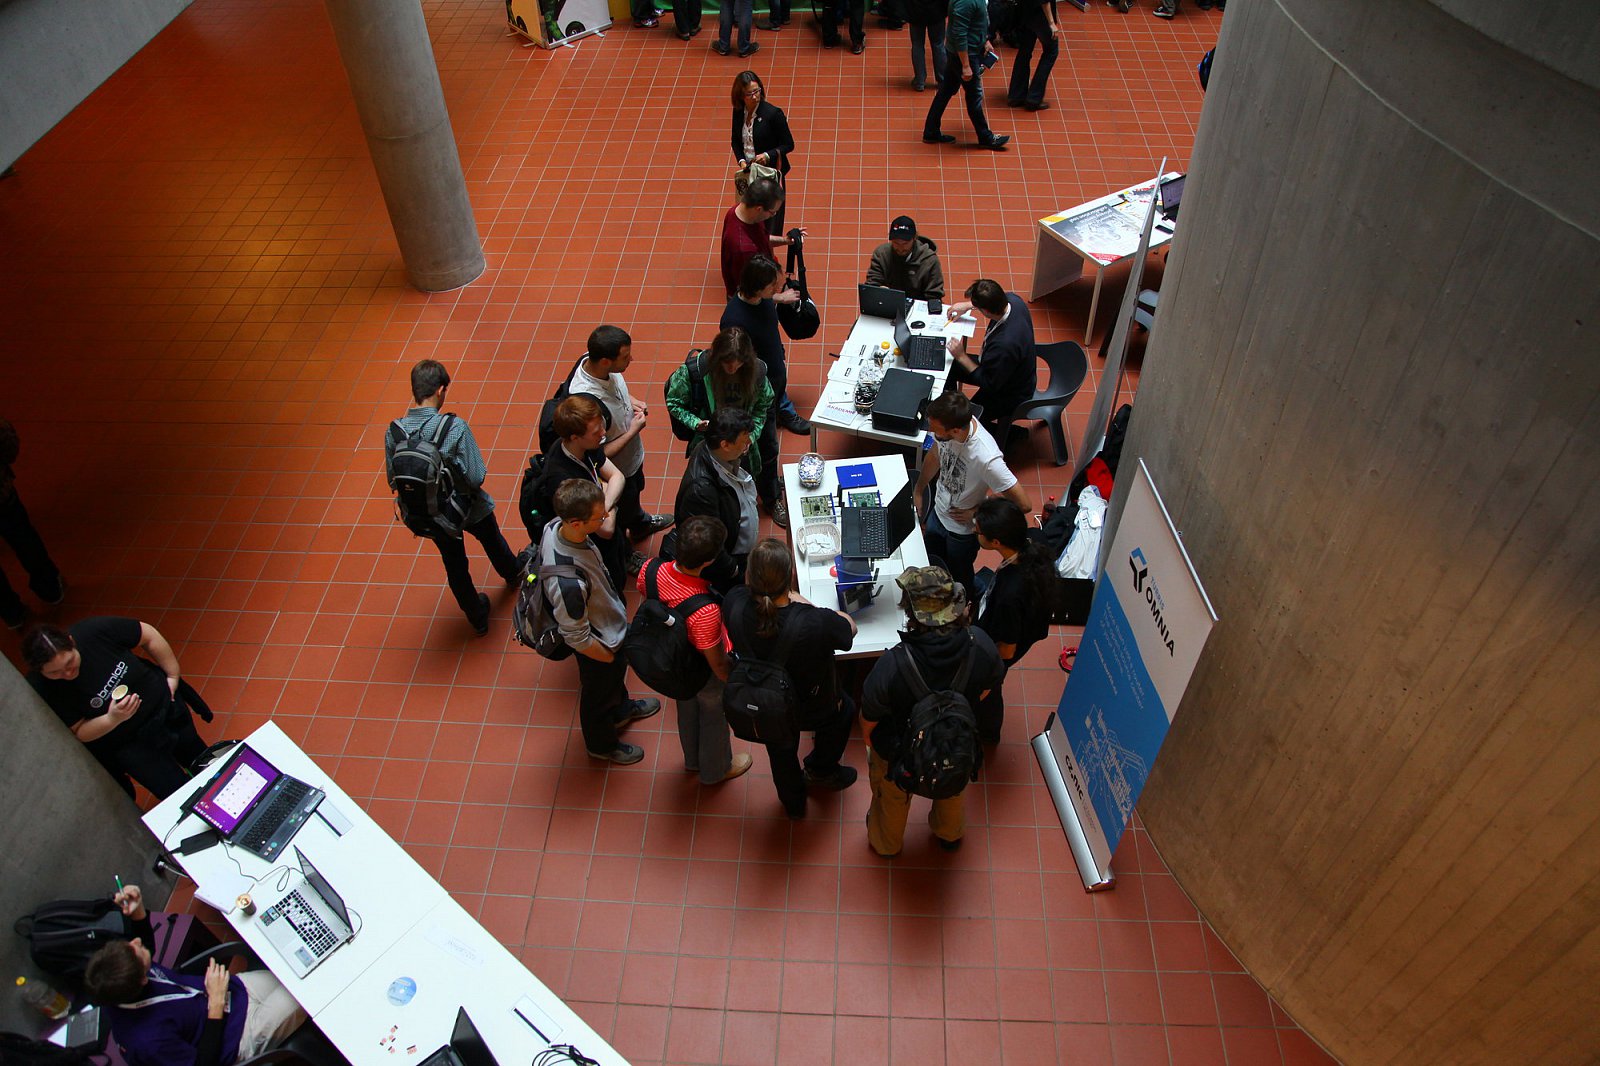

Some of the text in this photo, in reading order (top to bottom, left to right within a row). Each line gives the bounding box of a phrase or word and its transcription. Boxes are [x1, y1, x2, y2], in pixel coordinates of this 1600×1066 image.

[1146, 587, 1174, 657] OMNIA
[97, 661, 126, 699] brmlab
[1066, 755, 1084, 800] cz.nic
